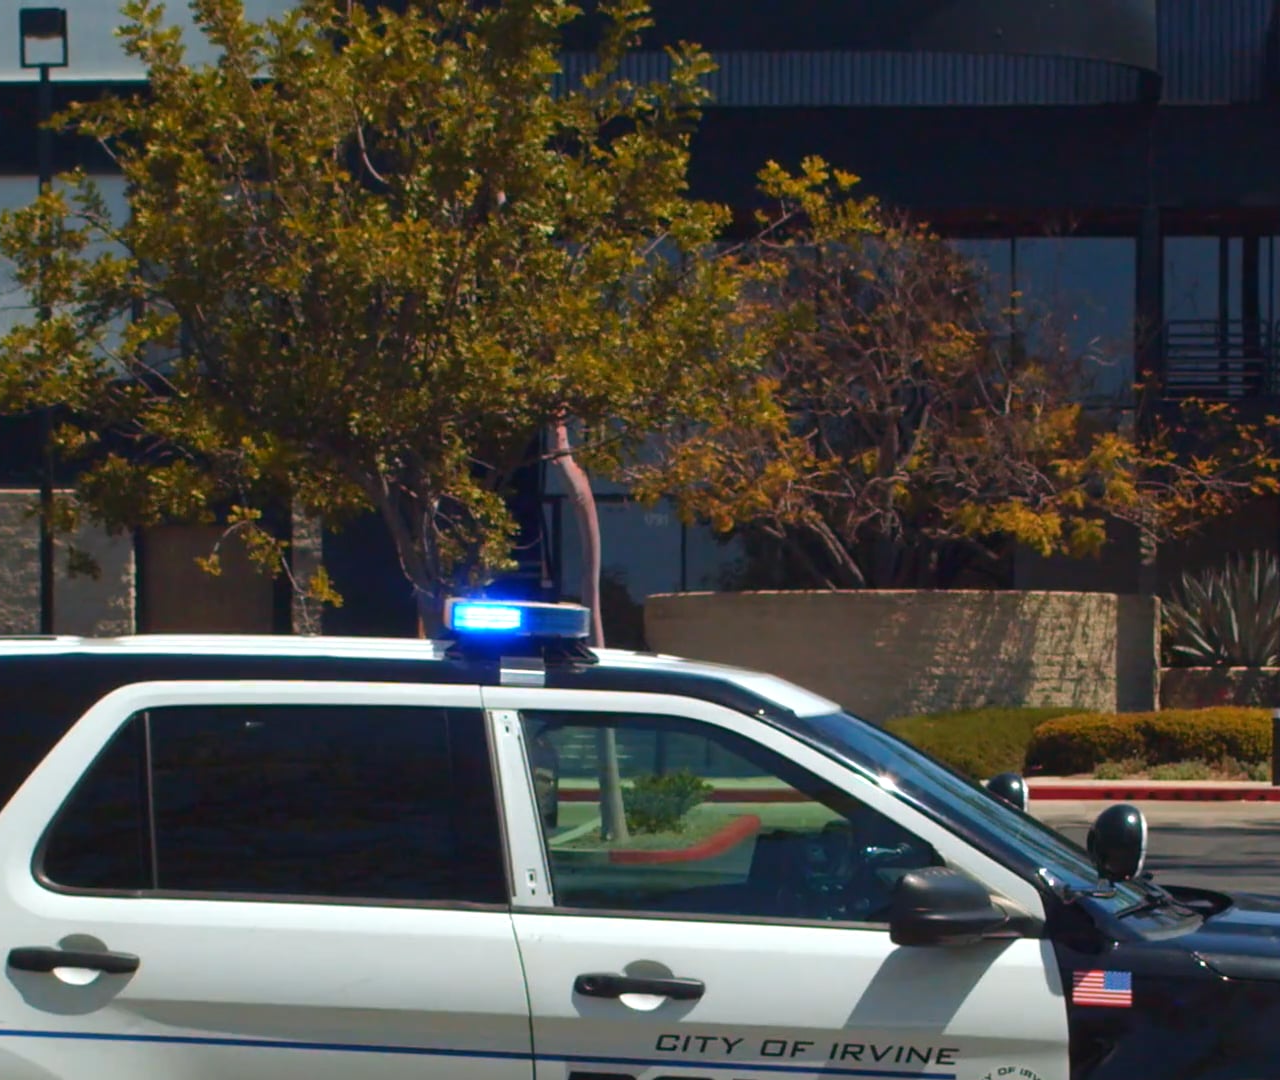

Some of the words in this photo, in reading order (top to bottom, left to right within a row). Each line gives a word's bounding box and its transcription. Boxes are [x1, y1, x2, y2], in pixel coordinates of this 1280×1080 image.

[655, 1034, 744, 1054] CITY
[759, 1039, 814, 1057] OF
[829, 1042, 960, 1065] IRVINE
[997, 1066, 1016, 1076] OF
